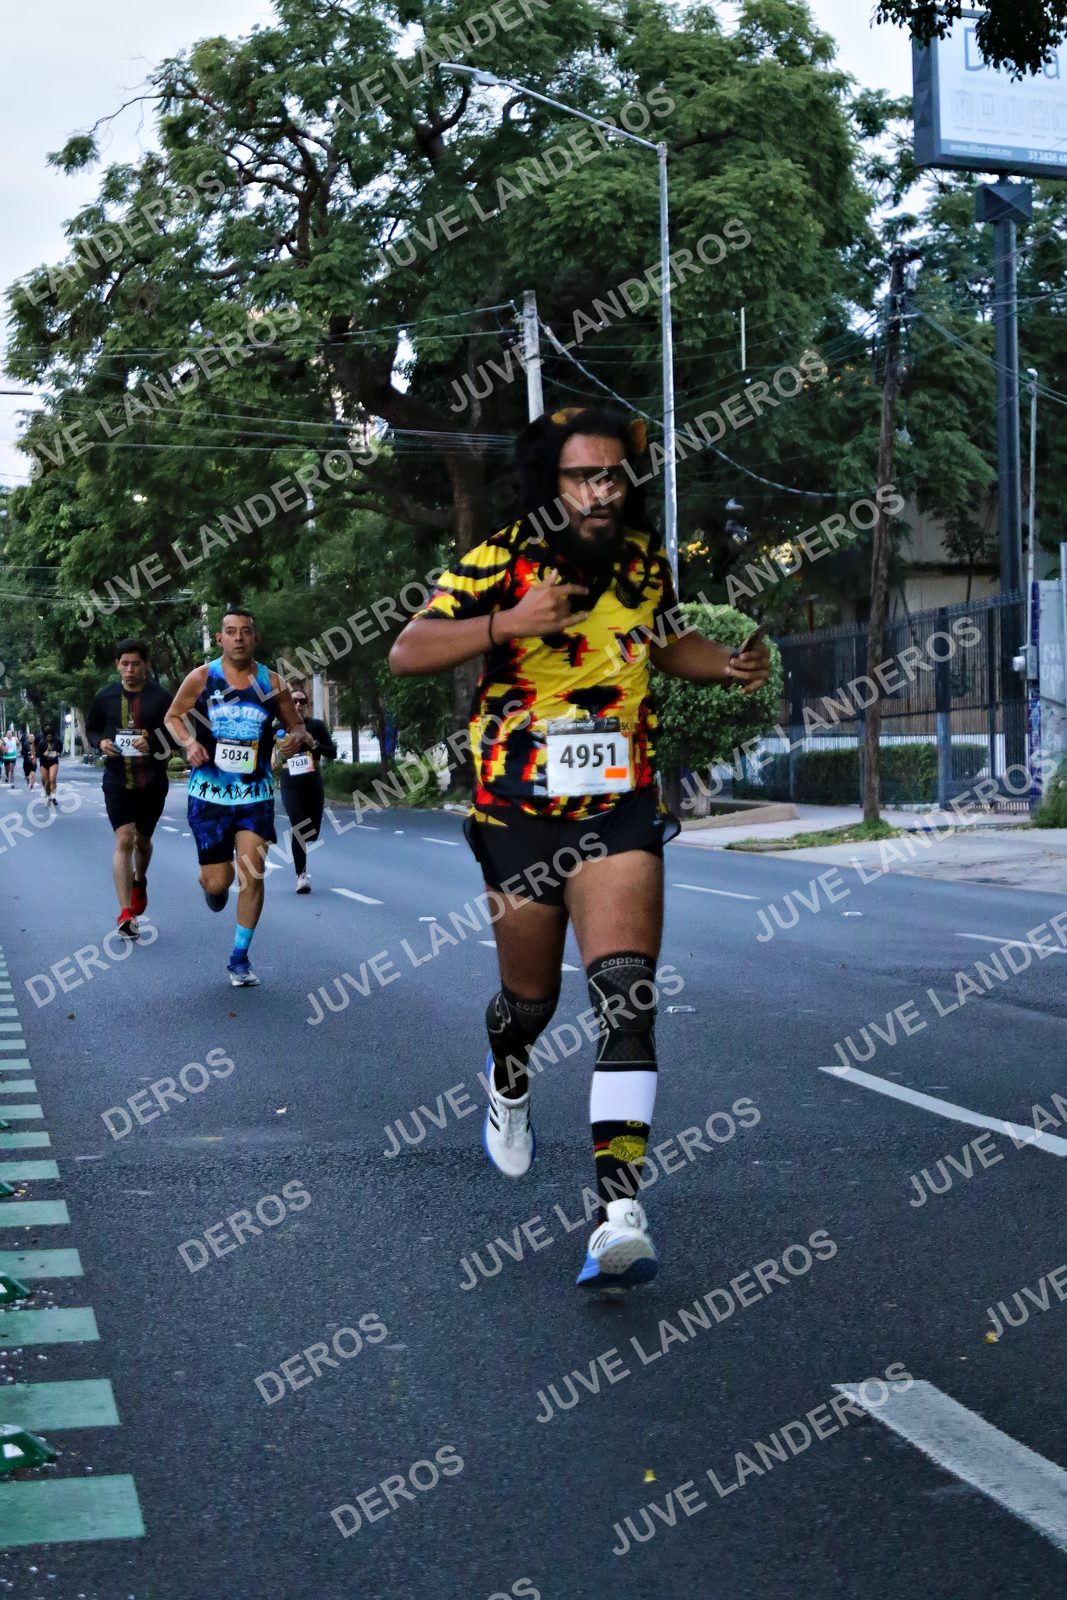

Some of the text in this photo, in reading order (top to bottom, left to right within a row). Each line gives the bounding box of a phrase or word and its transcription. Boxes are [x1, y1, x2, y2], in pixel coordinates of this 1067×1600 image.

[621, 723, 631, 731] 5K
[120, 738, 134, 747] 29
[221, 749, 249, 761] 5034
[560, 742, 616, 768] 4951
[291, 758, 309, 768] 7638
[601, 957, 646, 968] copper
